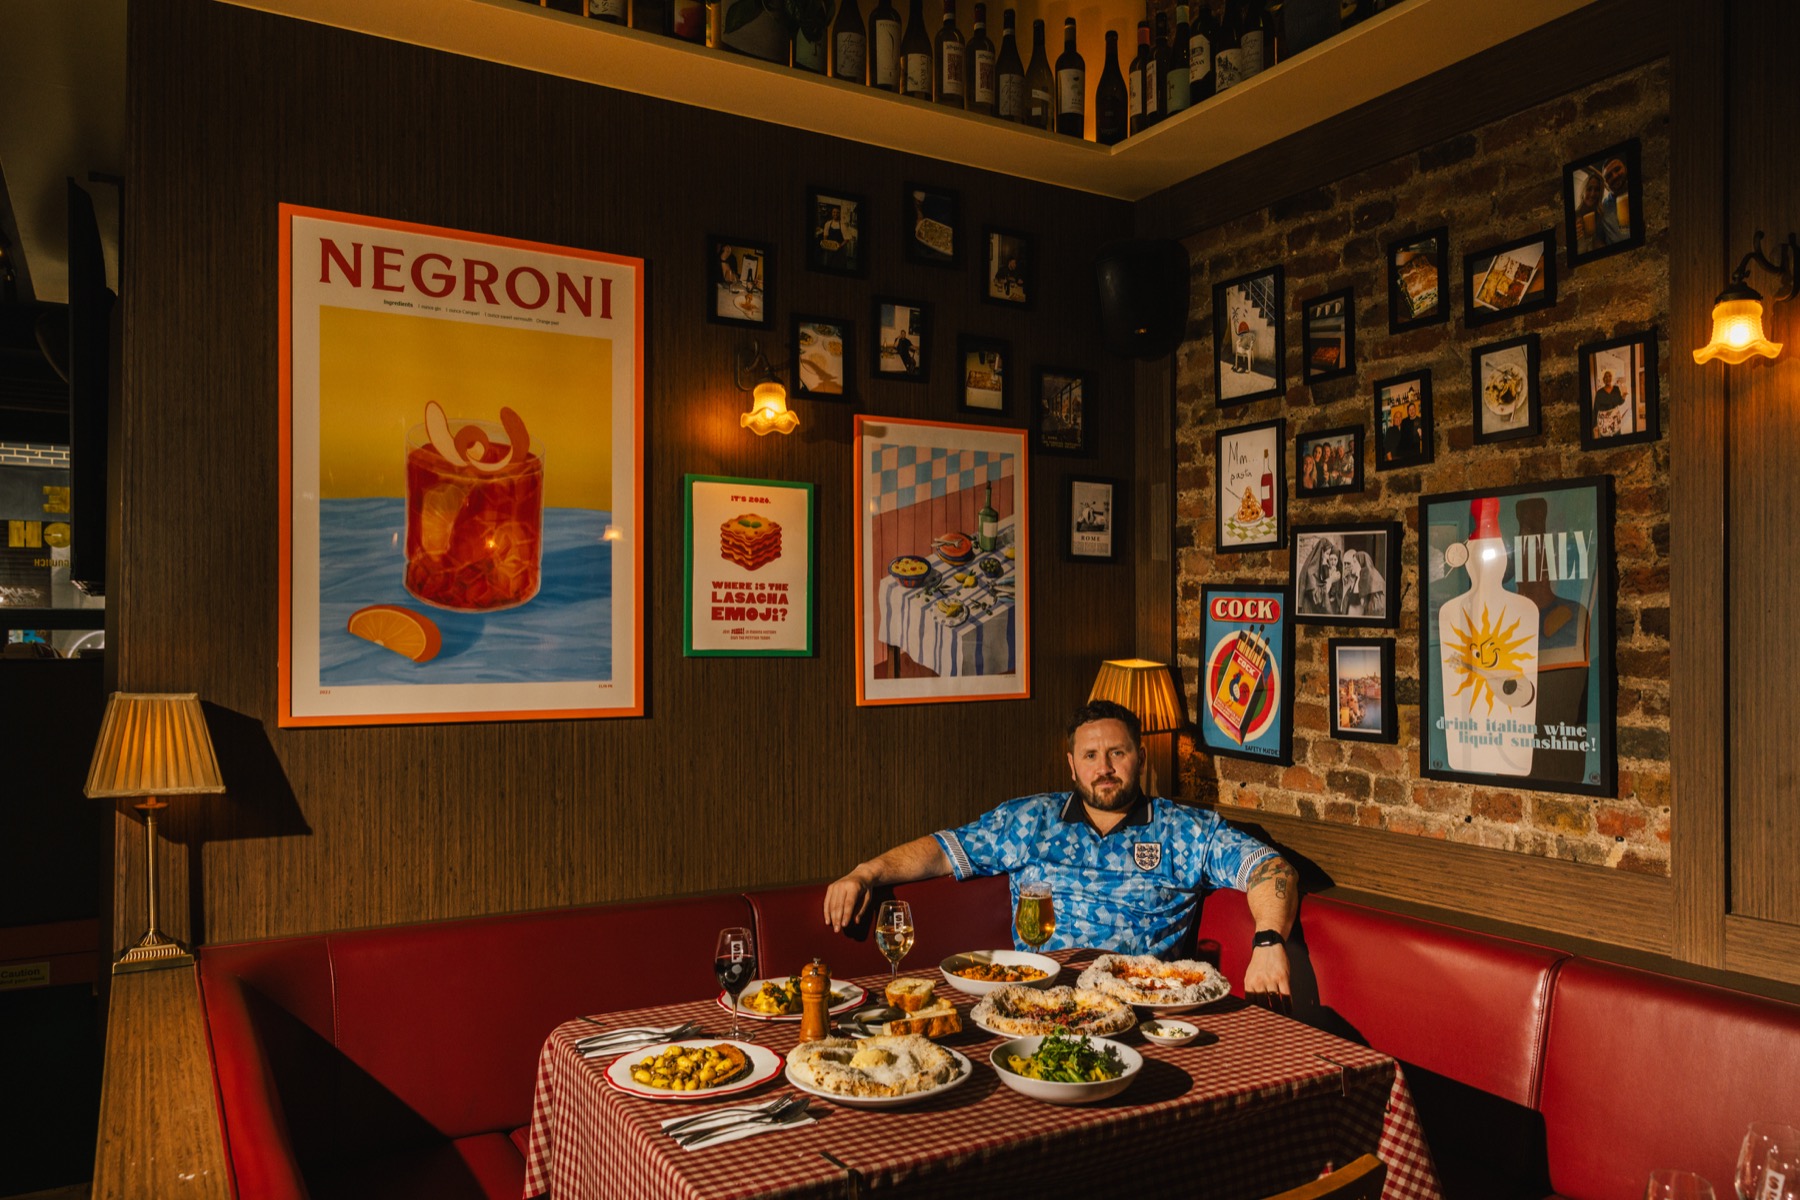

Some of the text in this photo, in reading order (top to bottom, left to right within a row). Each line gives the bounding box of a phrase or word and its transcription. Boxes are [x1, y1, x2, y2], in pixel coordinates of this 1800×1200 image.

[319, 237, 613, 320] NEGRONI
[383, 299, 414, 309] Ingredients
[1230, 469, 1253, 486] pasta
[1514, 529, 1594, 583] ITALY
[711, 581, 752, 590] WHERE
[768, 583, 789, 591] THE
[711, 591, 789, 605] LASAGNA
[1215, 599, 1274, 621] COCK
[1237, 657, 1256, 677] COCK
[1436, 716, 1588, 738] drink italian wine
[1245, 745, 1262, 753] SAFETY
[1458, 731, 1597, 752] liquid sunshine!
[1, 968, 40, 978] Caution
